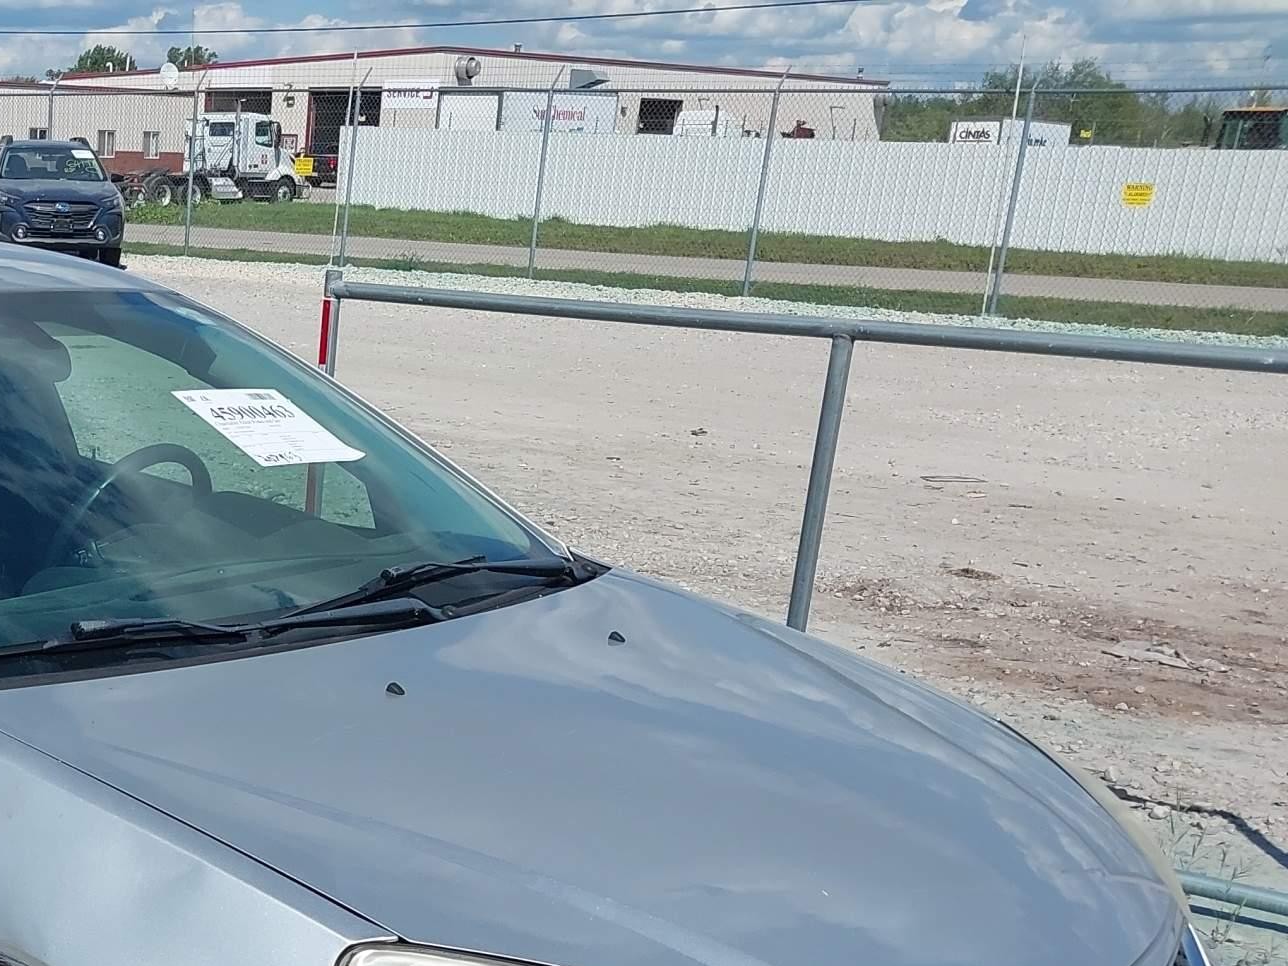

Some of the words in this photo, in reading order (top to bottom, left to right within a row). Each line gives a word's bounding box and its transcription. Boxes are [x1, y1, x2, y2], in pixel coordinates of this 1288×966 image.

[386, 87, 421, 98] SERVICE
[958, 128, 991, 140] CINTAS
[209, 404, 296, 421] 45900463
